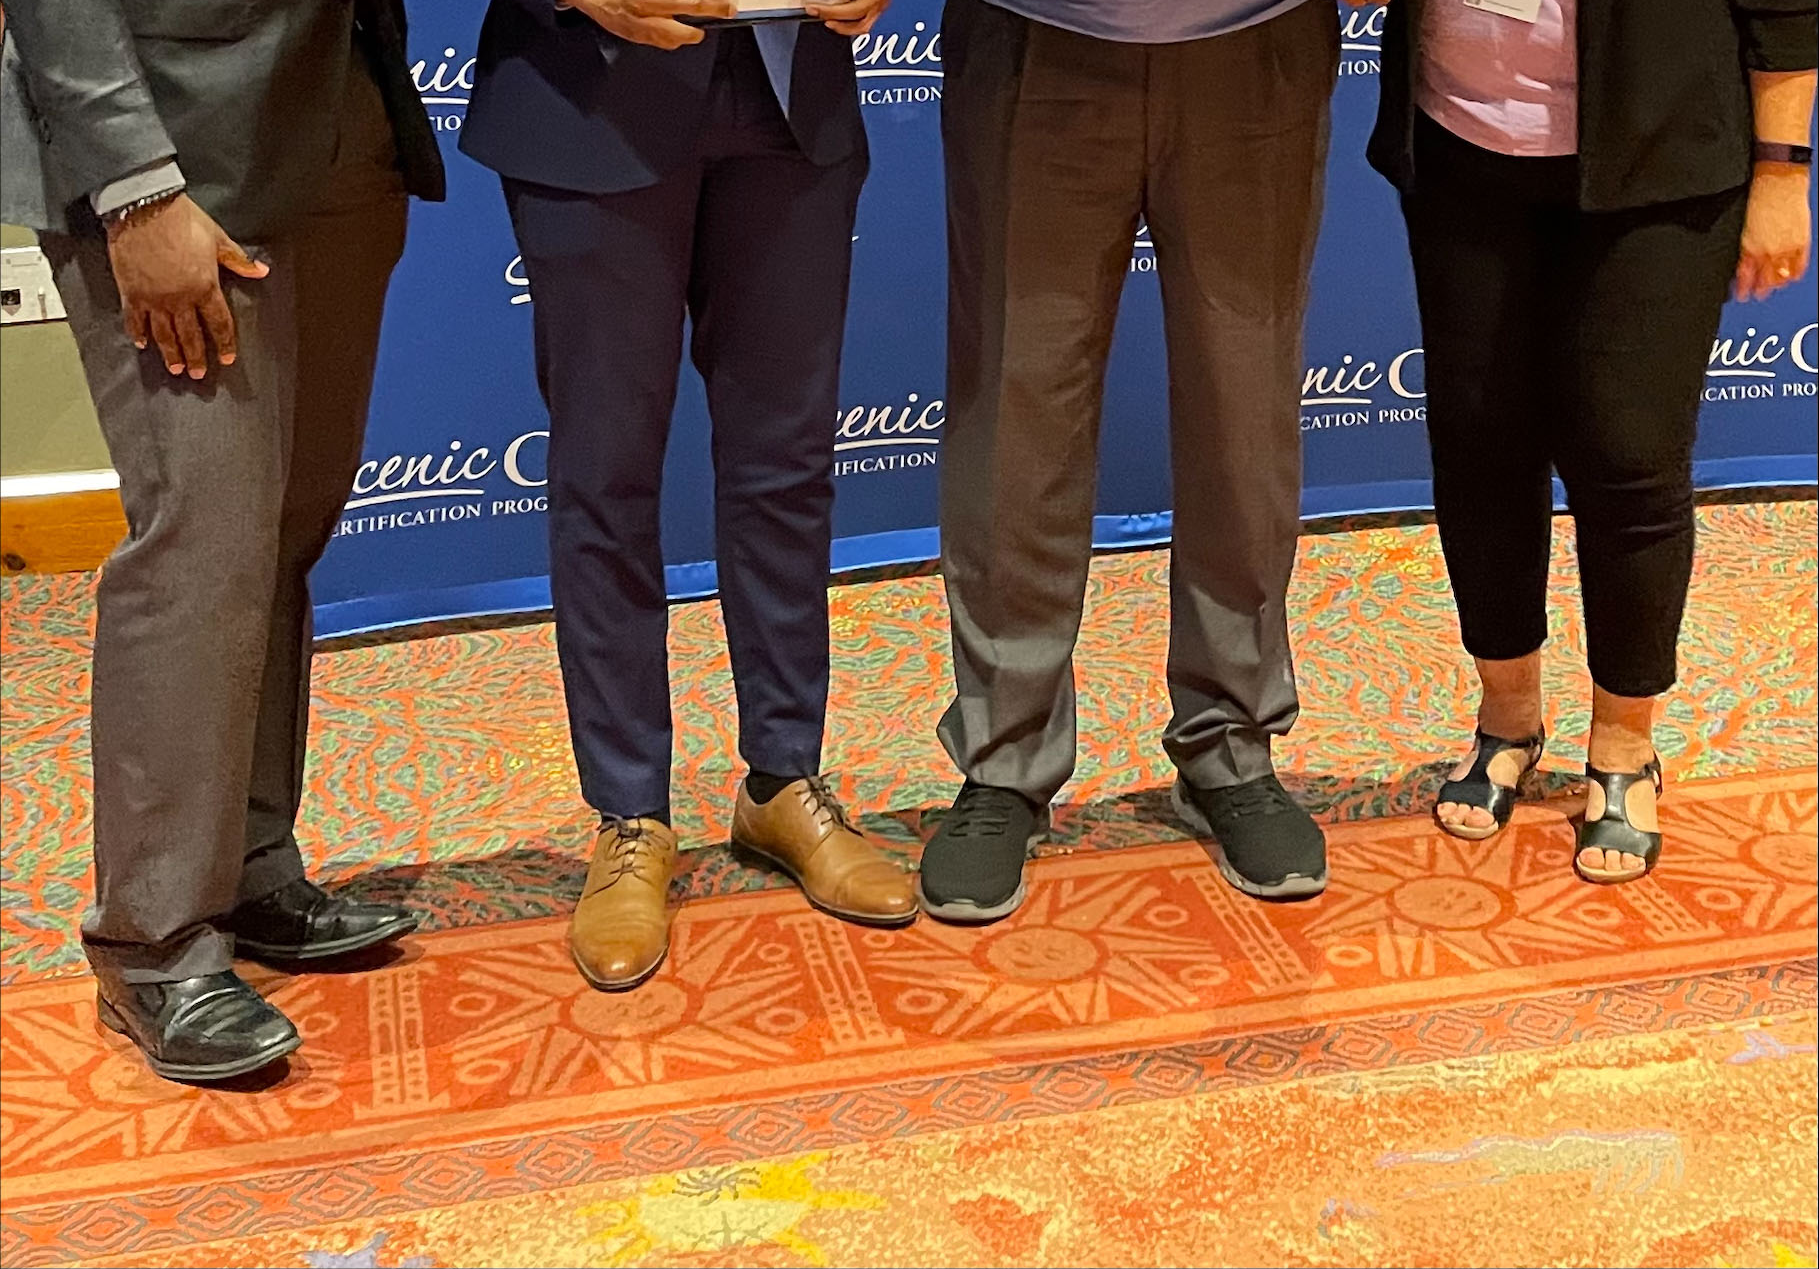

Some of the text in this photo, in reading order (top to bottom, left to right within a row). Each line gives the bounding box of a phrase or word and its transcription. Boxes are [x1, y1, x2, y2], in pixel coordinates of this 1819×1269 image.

[861, 86, 942, 105] ICATION
[1708, 327, 1785, 366] nic
[1301, 355, 1383, 396] nic
[836, 393, 945, 438] enic
[1378, 406, 1427, 423] PROG
[352, 440, 497, 494] cenic
[834, 451, 937, 476] IFICATION
[491, 496, 549, 516] PROG
